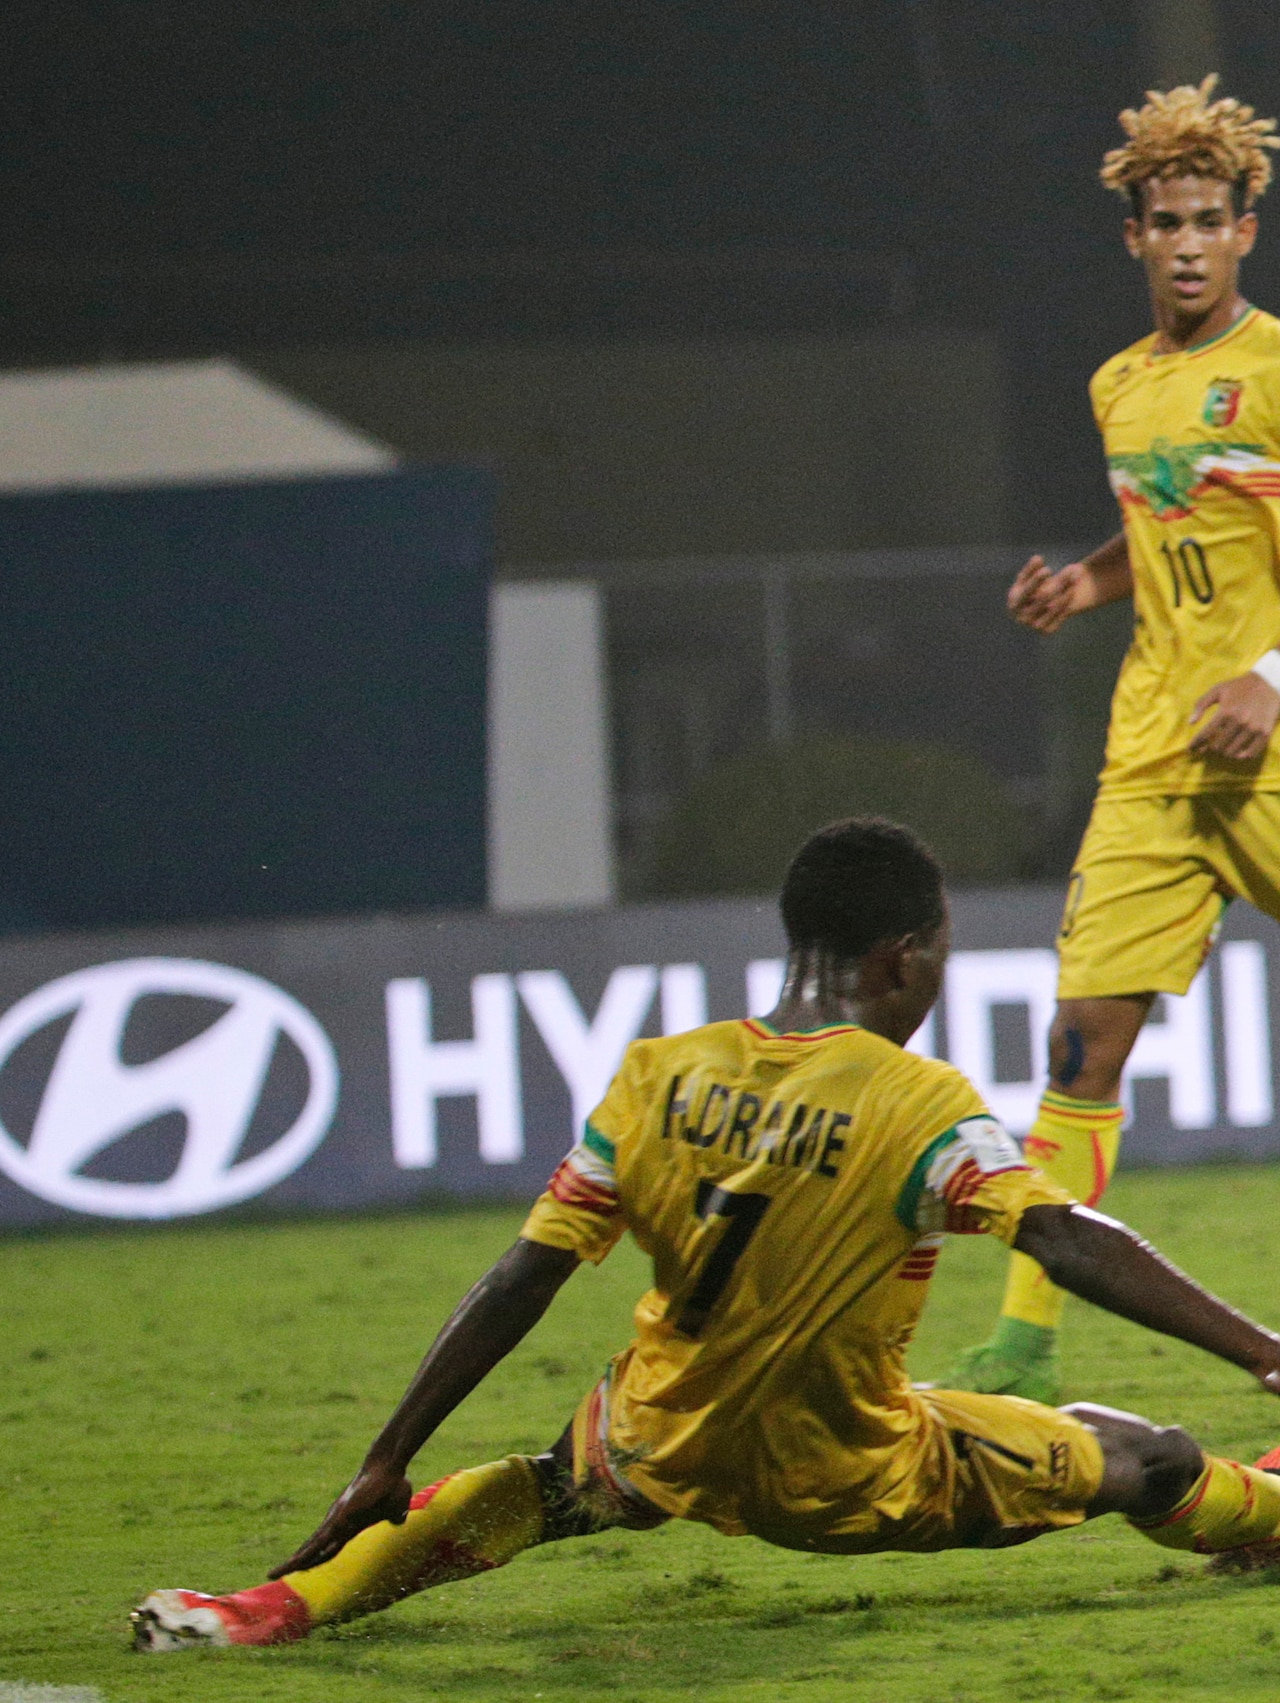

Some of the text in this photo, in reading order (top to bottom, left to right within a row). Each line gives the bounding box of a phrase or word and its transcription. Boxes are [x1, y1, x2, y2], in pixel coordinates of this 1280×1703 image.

[1161, 537, 1214, 609] 10
[385, 938, 1275, 1170] HYDAI
[676, 1181, 773, 1338] 7
